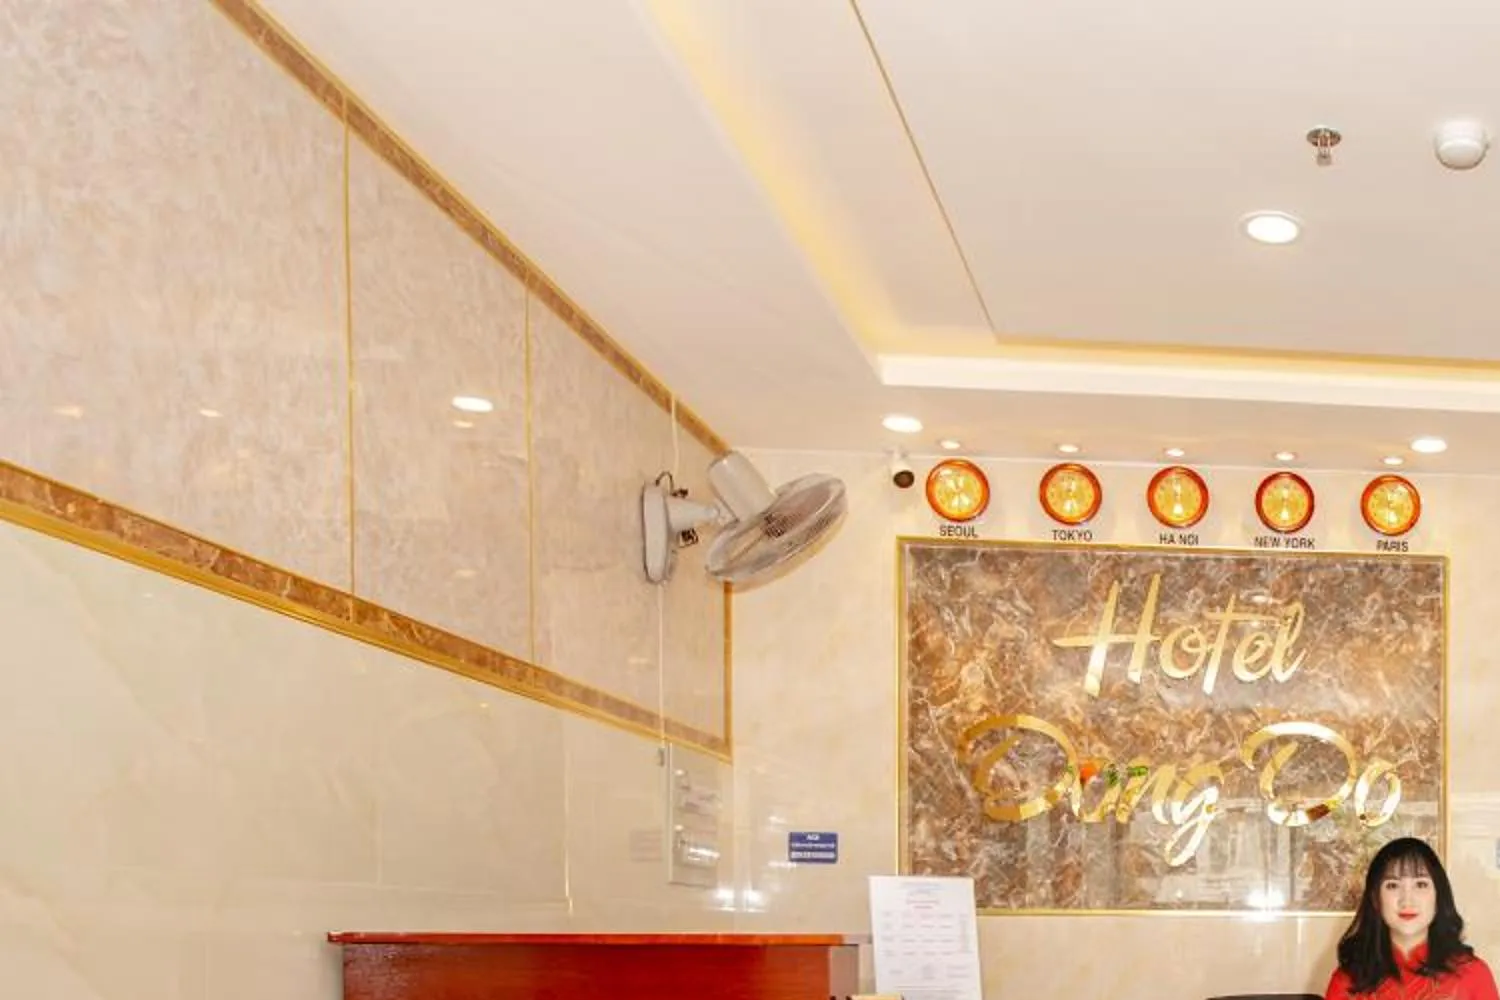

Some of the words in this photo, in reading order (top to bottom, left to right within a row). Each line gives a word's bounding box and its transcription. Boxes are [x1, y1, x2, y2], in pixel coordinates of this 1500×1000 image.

[938, 524, 978, 539] SEOUL
[1052, 529, 1093, 542] TOKYO
[1159, 533, 1177, 545] HA
[1179, 534, 1199, 546] NOI
[1254, 536, 1281, 549] NEW
[1284, 537, 1316, 550] YORK
[1376, 540, 1409, 553] PARIS
[1053, 573, 1310, 697] Hotel
